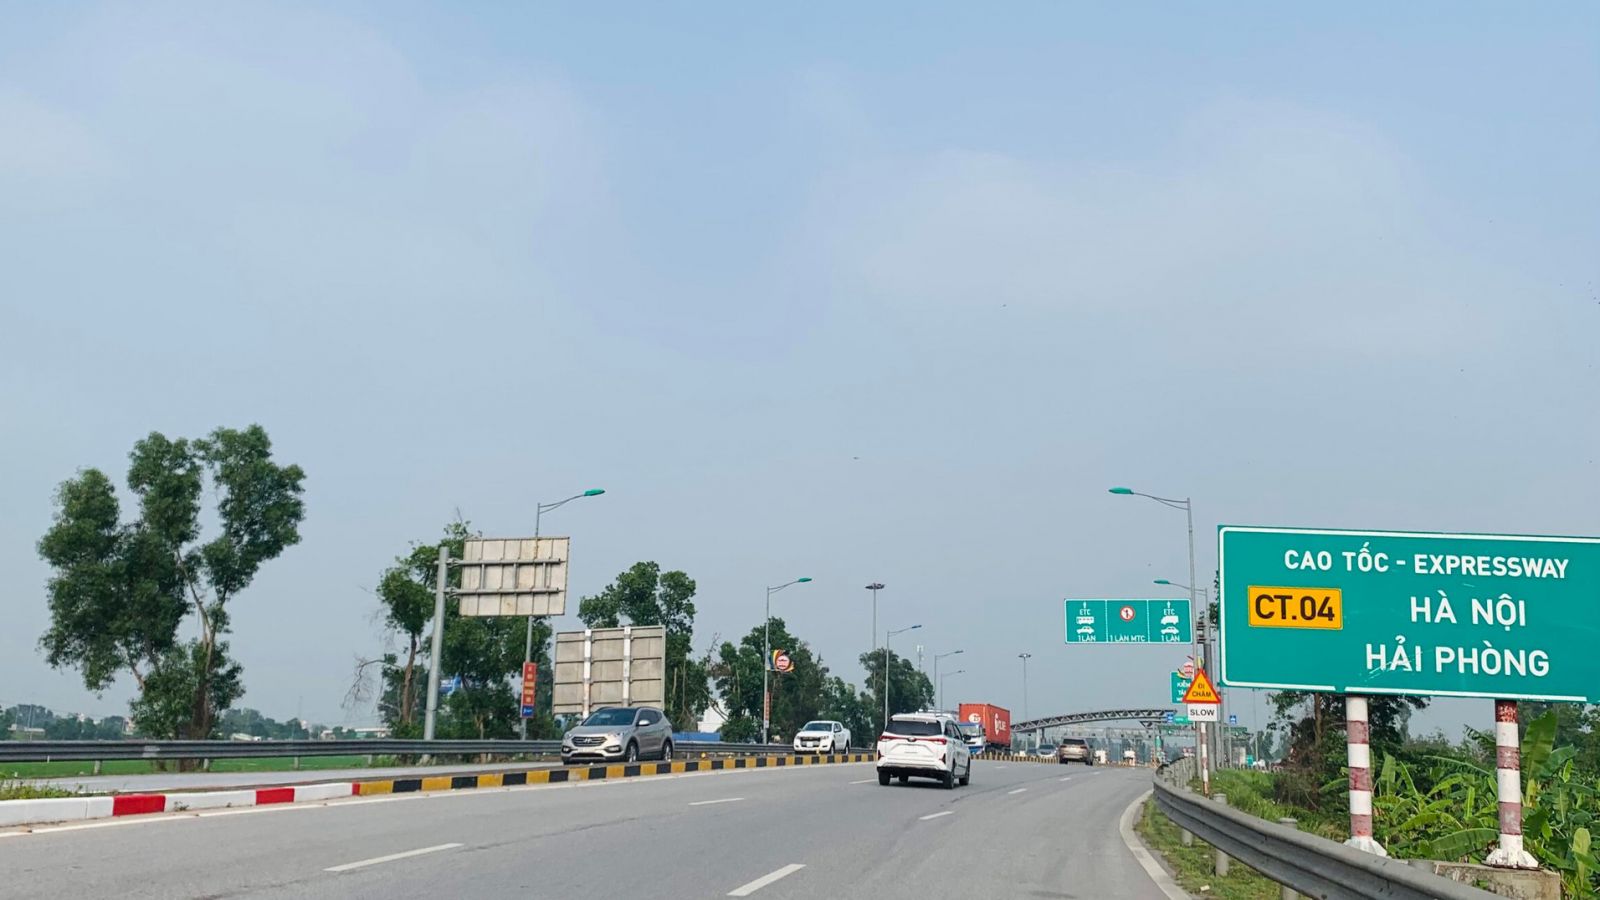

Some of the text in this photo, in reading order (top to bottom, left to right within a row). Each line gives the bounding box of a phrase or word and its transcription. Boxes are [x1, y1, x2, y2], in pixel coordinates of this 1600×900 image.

[1284, 550, 1332, 570] CAO
[1342, 542, 1389, 573] TỐC
[1414, 554, 1569, 578] EXPRESSWAY
[1255, 594, 1335, 622] CT.04
[1410, 590, 1526, 631] HÀ NỘI
[1365, 635, 1549, 677] HẢI PHÒNG
